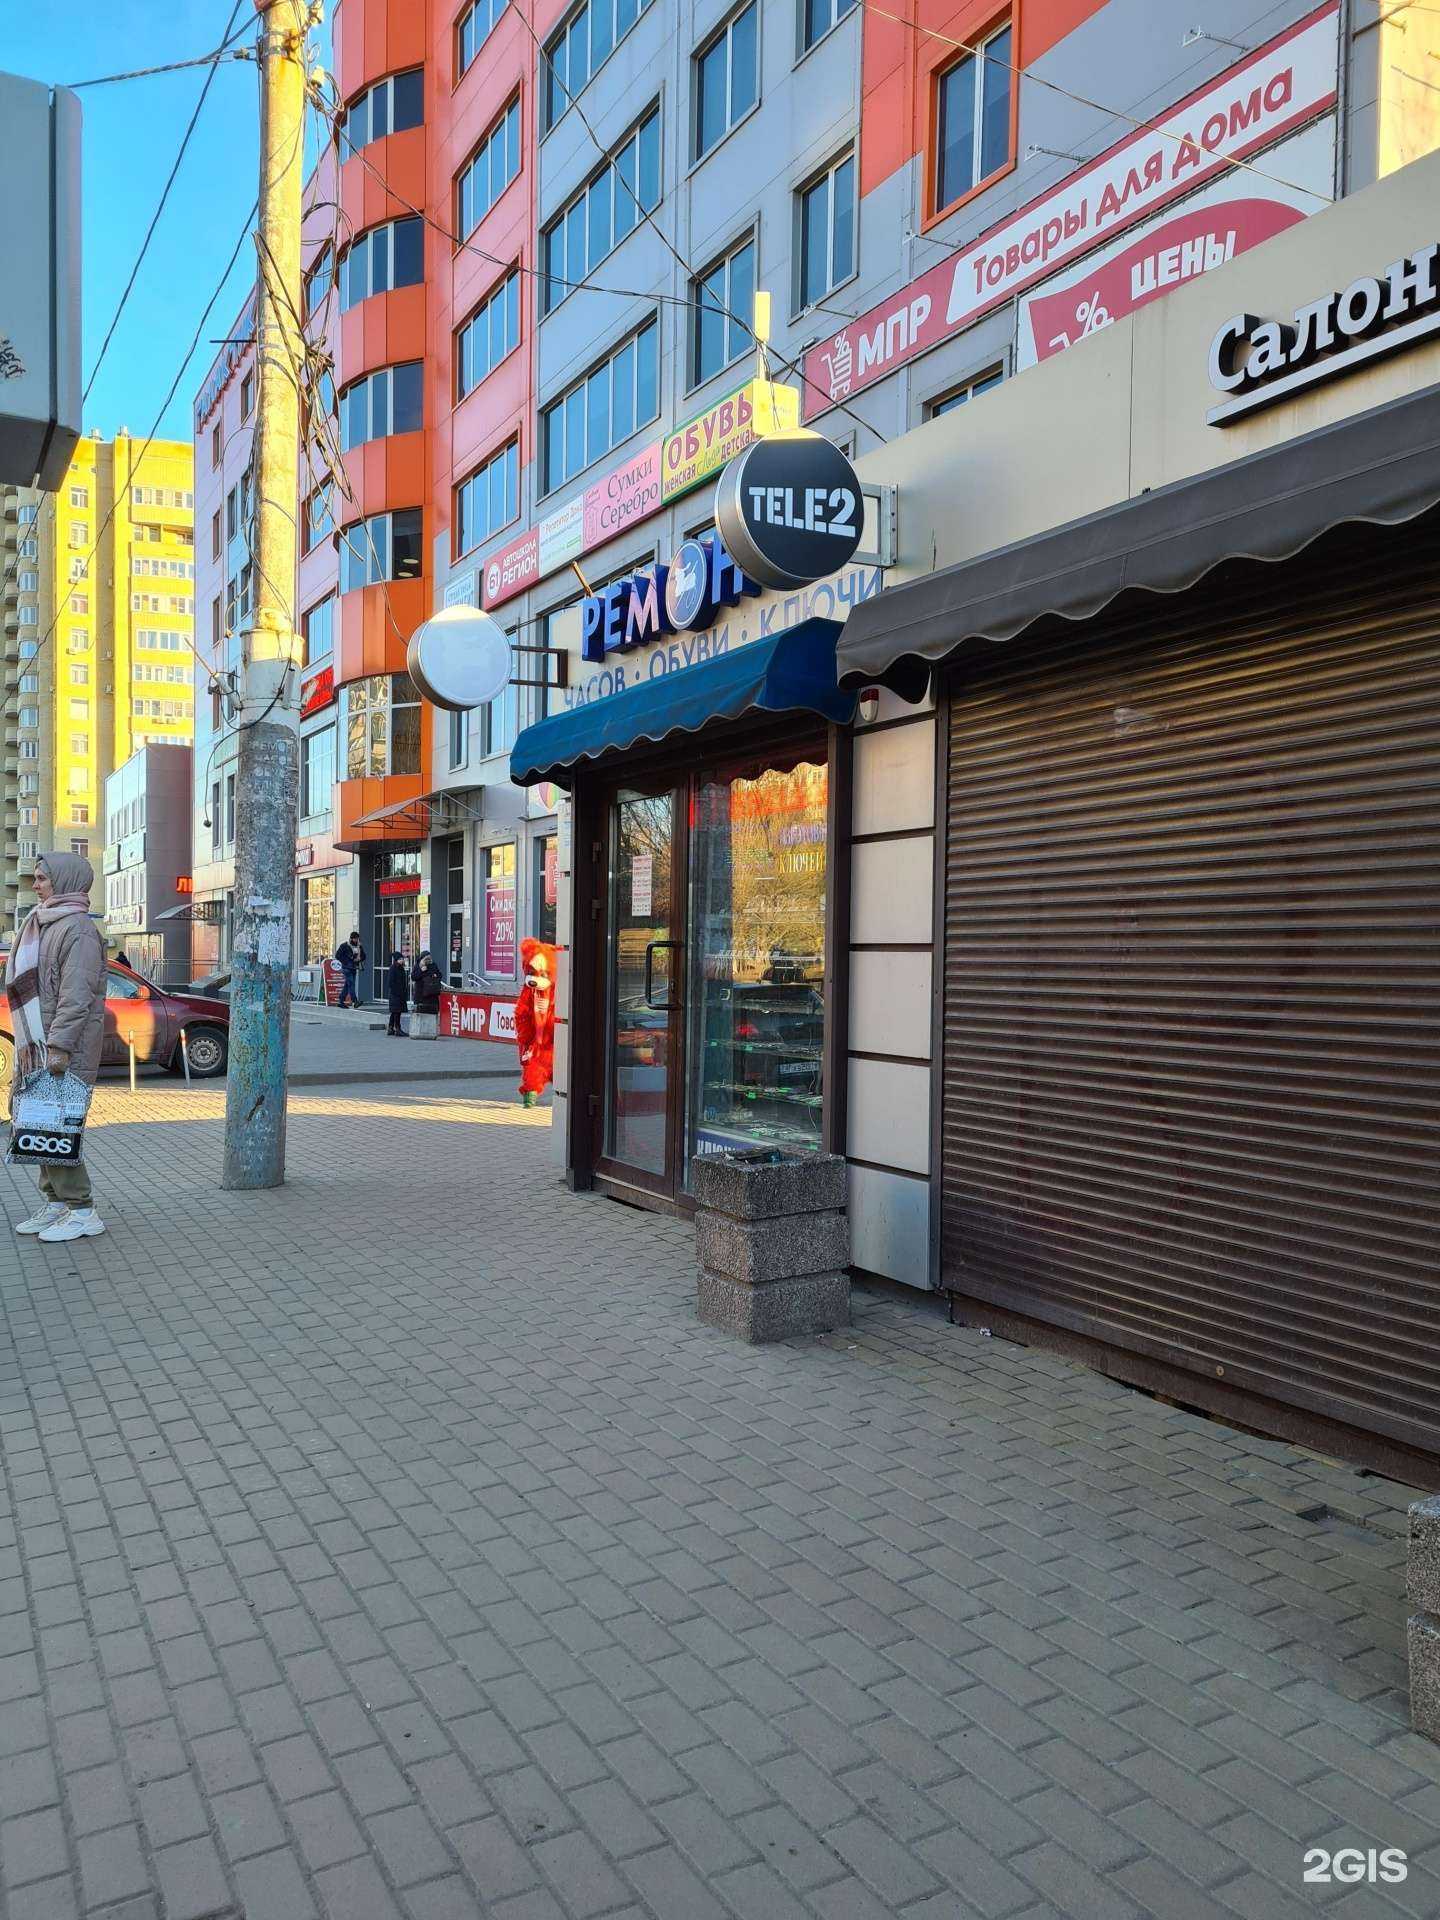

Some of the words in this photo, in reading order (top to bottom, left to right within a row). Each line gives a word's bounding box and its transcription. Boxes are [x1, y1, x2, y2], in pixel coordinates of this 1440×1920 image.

[858, 294, 932, 377] МПР
[973, 199, 1088, 294] Товары
[1095, 159, 1163, 226] для
[1172, 65, 1294, 180] дома
[1131, 230, 1237, 301] ЦЕНЫ
[1208, 241, 1440, 391] Салон
[667, 392, 753, 470] ОБУВЬ
[607, 457, 653, 501] Сумки
[663, 463, 696, 494] женская
[600, 482, 658, 528] Серебро
[748, 486, 856, 538] TELE2
[501, 552, 537, 588] РЕГИОН
[503, 538, 537, 568] АВТОШКОЛА
[582, 536, 744, 662] РЕМОН
[649, 624, 729, 681] ОБУВИ
[760, 566, 881, 636] КЛЮЧИ
[490, 895, 515, 913] Скидк
[460, 1006, 486, 1033] МПР
[18, 1134, 72, 1154] asos
